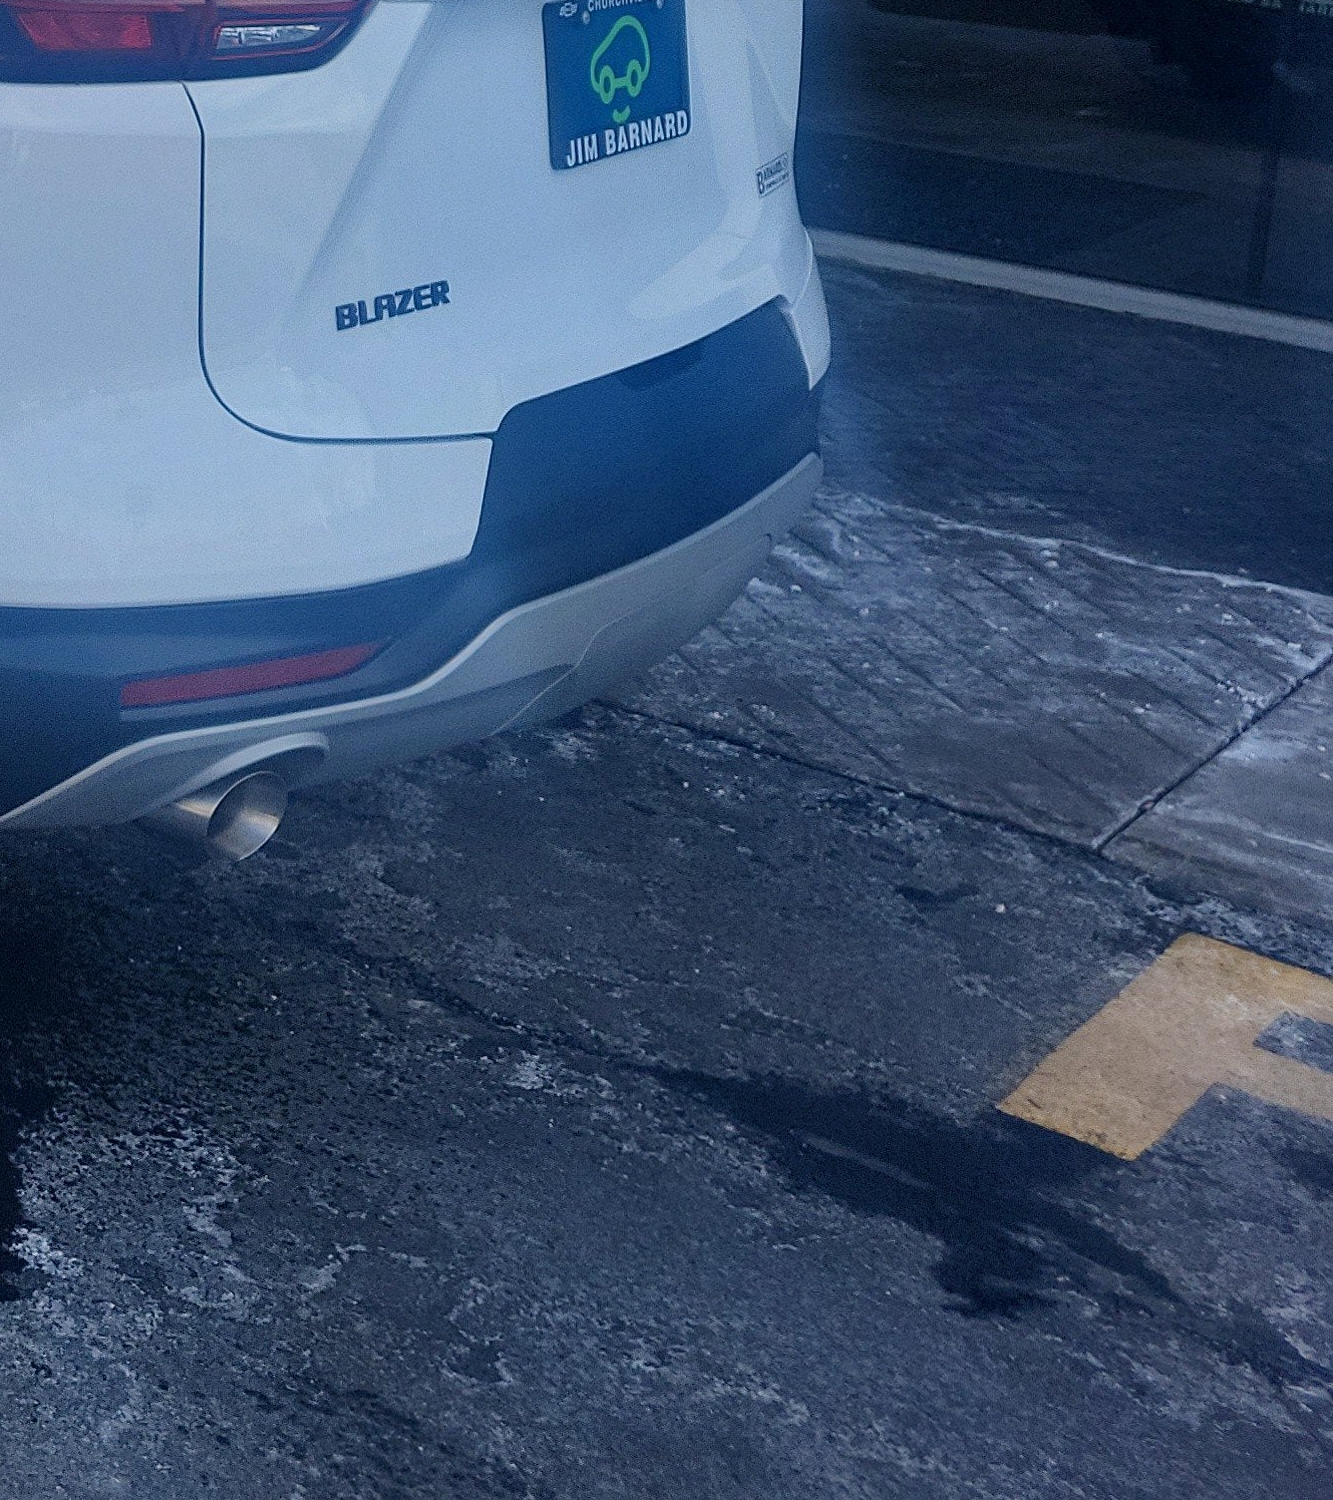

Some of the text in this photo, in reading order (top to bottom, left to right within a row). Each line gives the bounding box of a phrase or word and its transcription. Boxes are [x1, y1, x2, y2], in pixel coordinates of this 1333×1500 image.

[566, 109, 688, 168] JIM BARNARD
[335, 280, 451, 331] BLAZER
